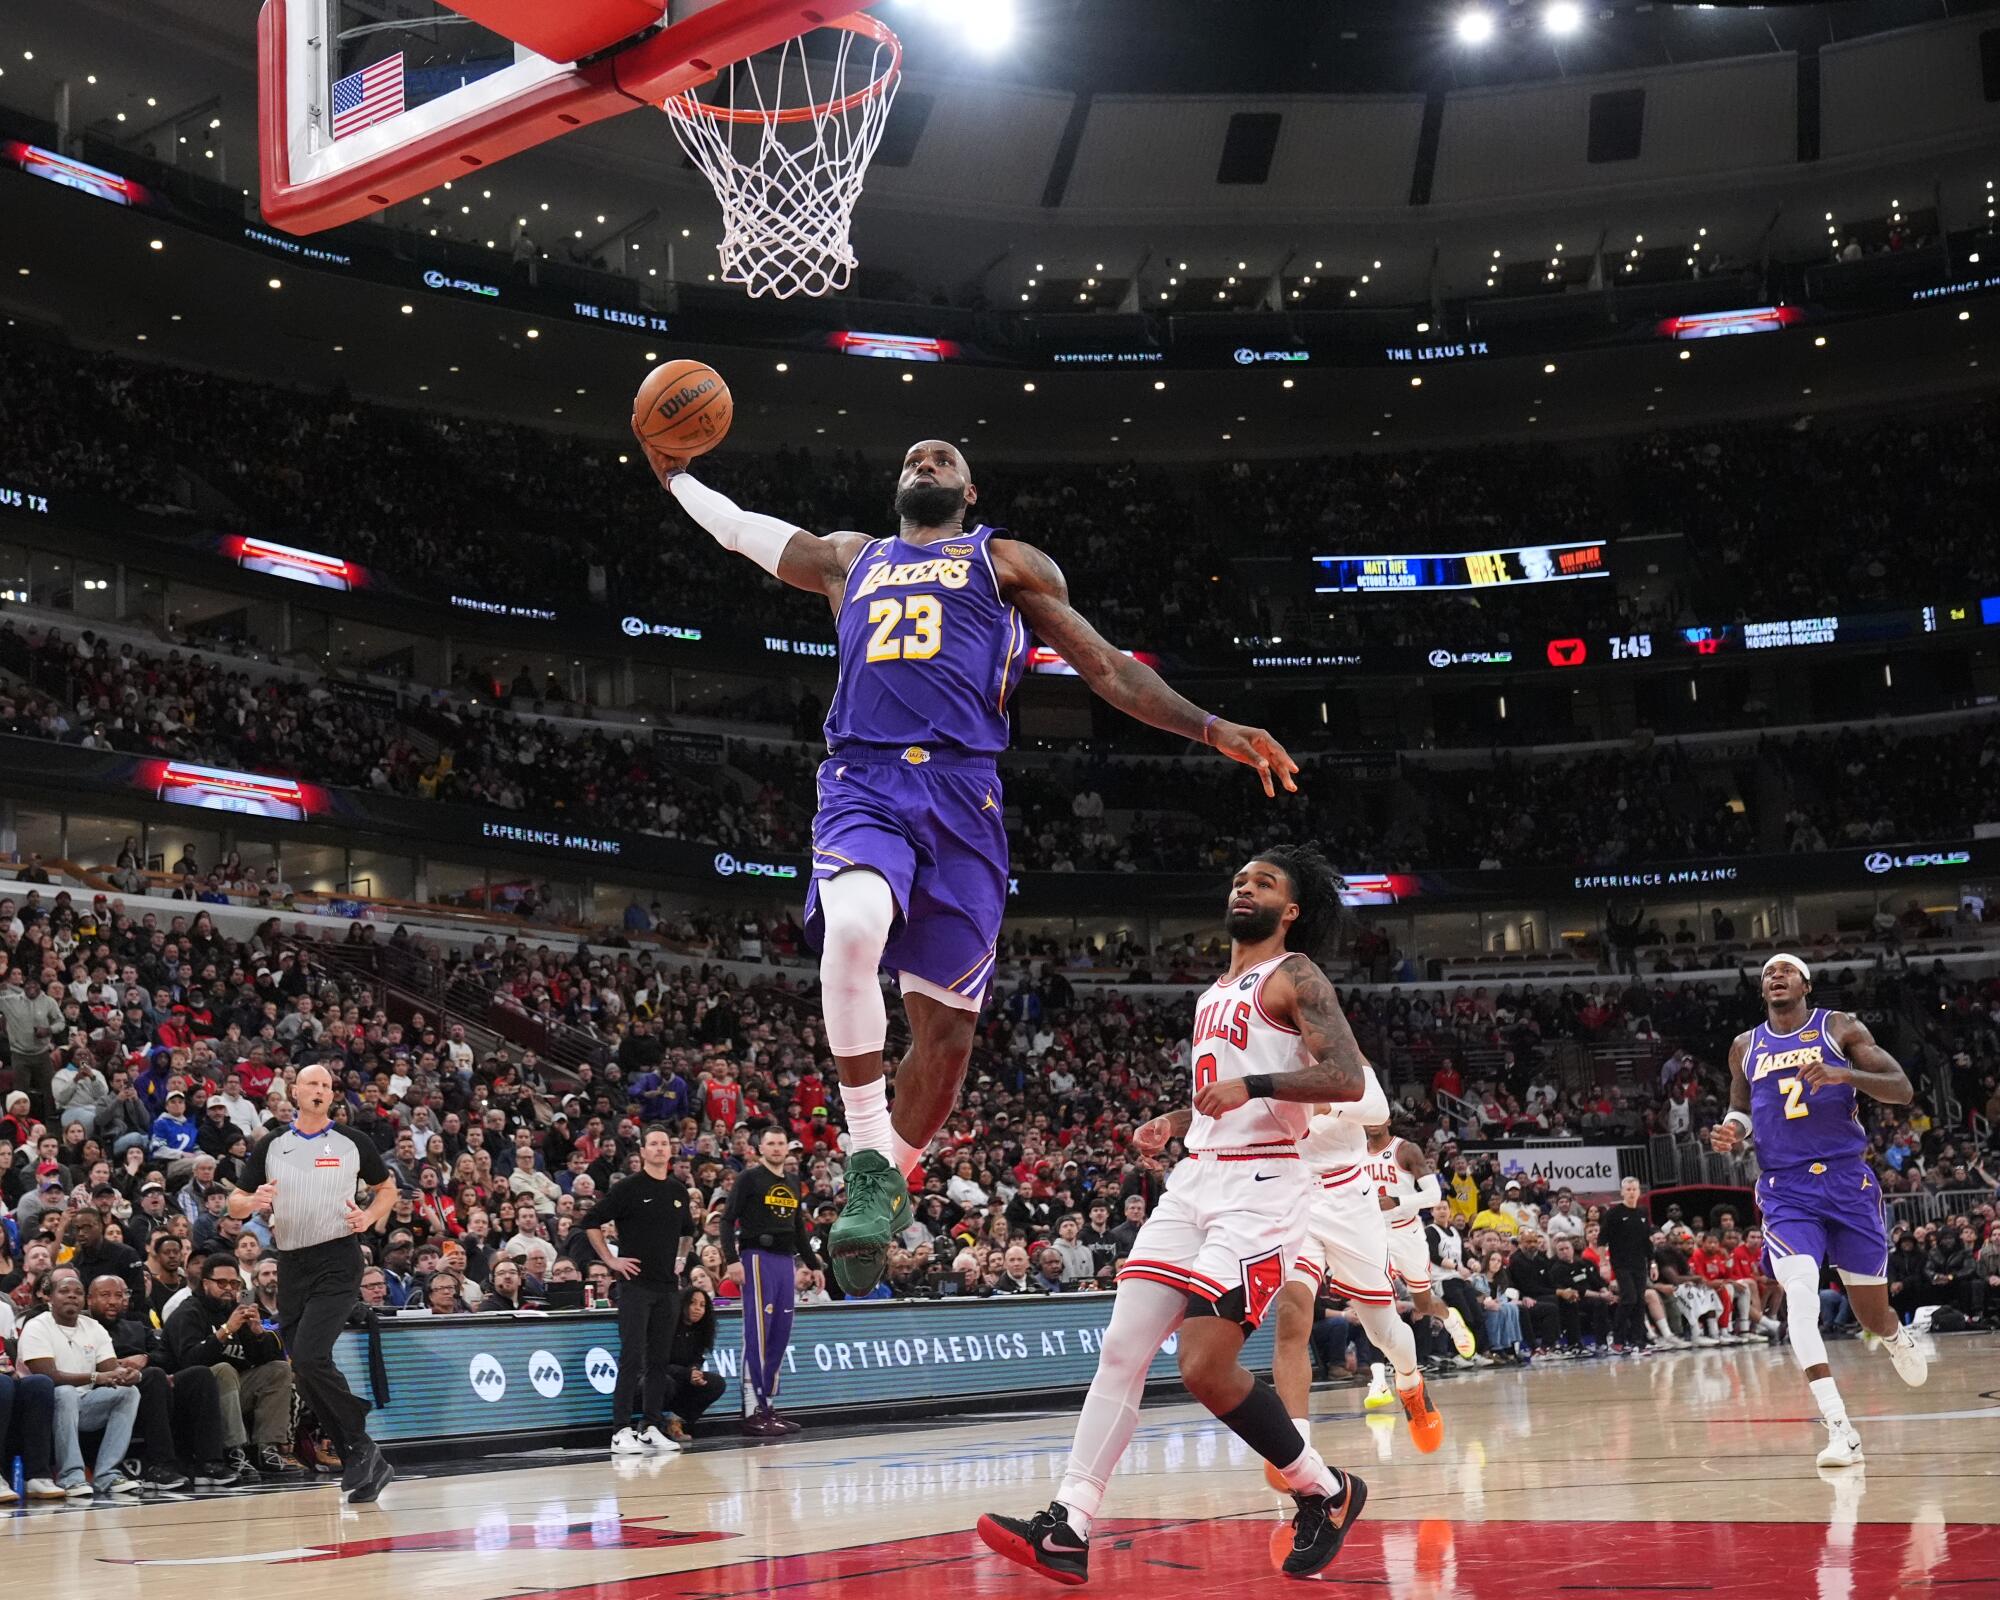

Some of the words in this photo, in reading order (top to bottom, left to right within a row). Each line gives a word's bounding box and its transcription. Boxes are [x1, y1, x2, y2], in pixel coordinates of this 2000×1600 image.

[573, 302, 600, 318] THE
[603, 309, 646, 328] LEXUS
[650, 318, 668, 332] TX
[1386, 348, 1412, 360] THE
[1417, 345, 1464, 359] LEXUS
[1469, 342, 1488, 355] TX
[658, 379, 716, 419] Wilson
[28, 494, 48, 514] TX
[944, 546, 972, 556] bibigo
[1363, 560, 1387, 575] MATT
[1388, 560, 1408, 575] RIFE
[851, 558, 972, 604] LAKERS
[866, 594, 943, 663] 23
[1744, 620, 1790, 636] MEMPHIS
[1790, 616, 1838, 633] GRIZZLIES
[764, 637, 790, 653] THE
[793, 641, 837, 657] LEXUS
[1609, 634, 1652, 660] 7:45
[1745, 633, 1791, 649] HOUSTON
[1791, 629, 1835, 645] ROCKETS
[1252, 656, 1312, 667] EXPERIENCE
[1316, 655, 1362, 666] AMAZING
[483, 823, 560, 846] EXPERIENCE
[564, 835, 621, 855] AMAZING
[1574, 874, 1662, 889] EXPERIENCE
[1668, 867, 1738, 884] AMAZING
[1752, 1046, 1824, 1082] LAKERS
[1778, 1077, 1809, 1120] 2
[1531, 1160, 1612, 1180] Advocate
[814, 1332, 1028, 1372] ORTHOPAEDICS
[1040, 1330, 1066, 1357] AT
